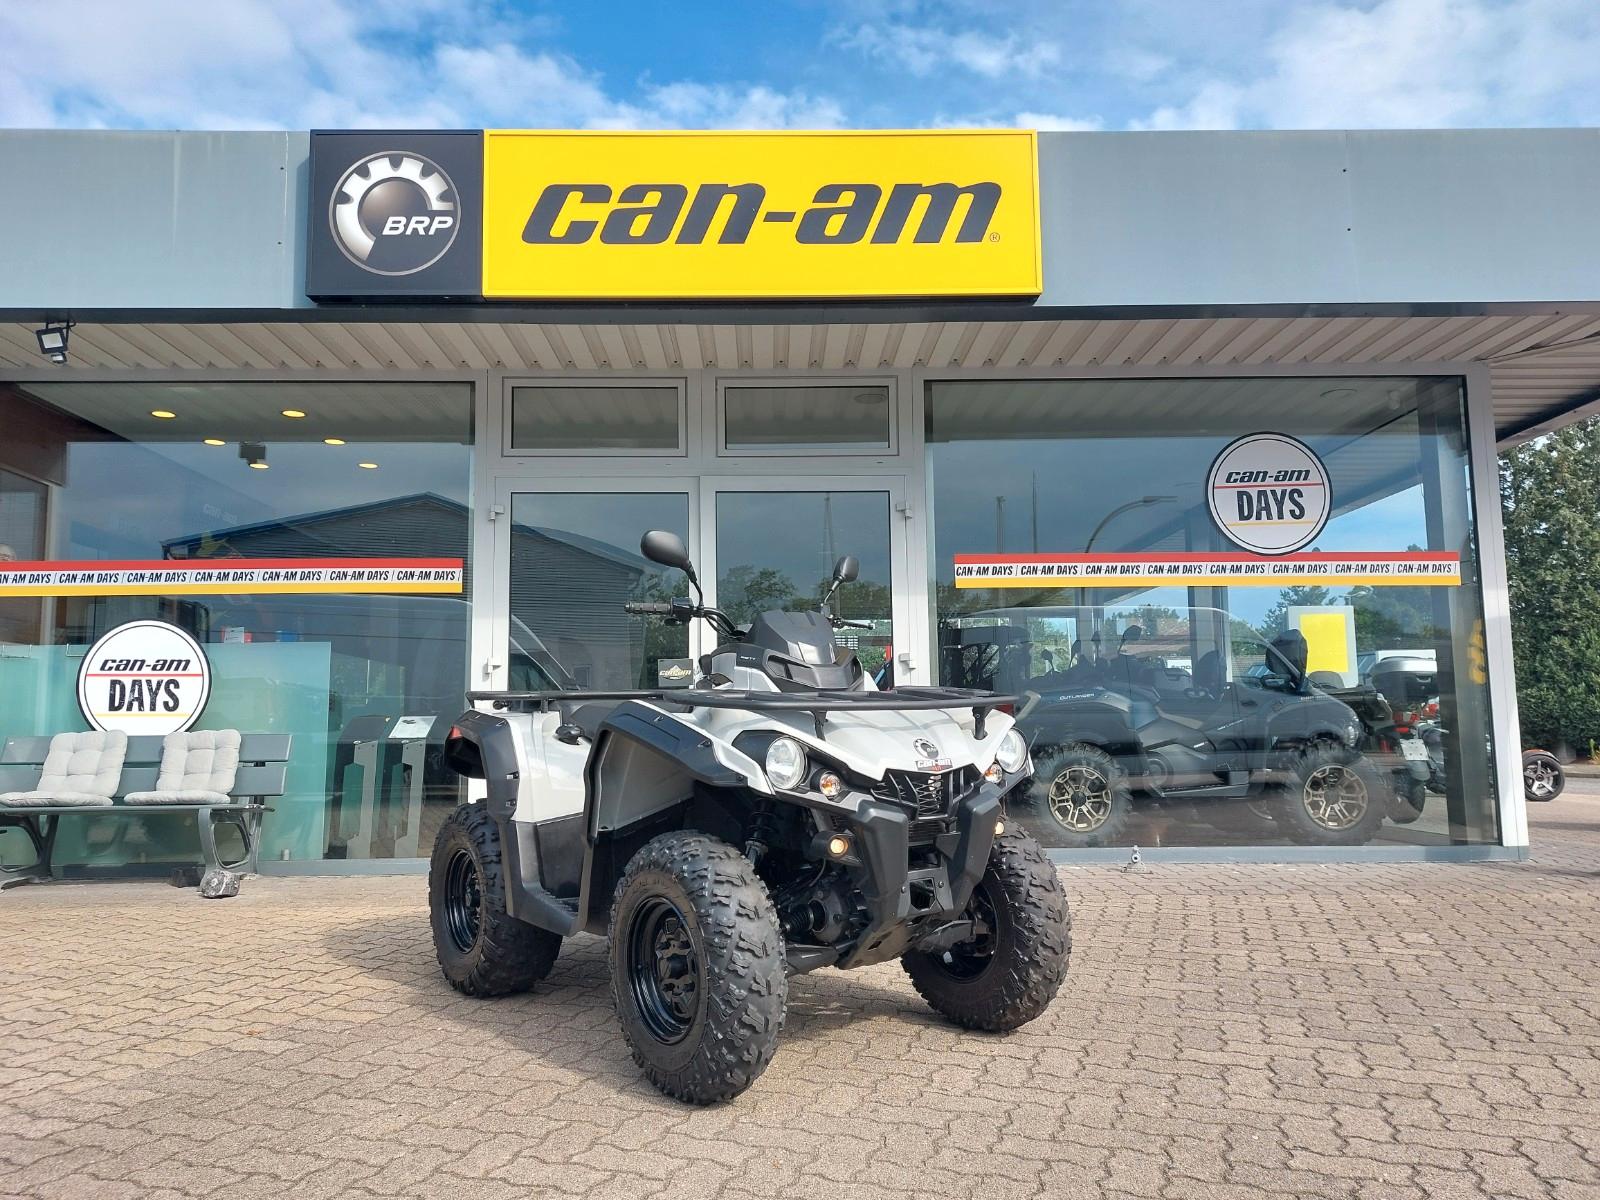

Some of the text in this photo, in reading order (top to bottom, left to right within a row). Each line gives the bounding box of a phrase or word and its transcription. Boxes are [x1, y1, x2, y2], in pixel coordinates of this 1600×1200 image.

[521, 181, 1002, 243] can-am
[381, 215, 454, 236] BRP
[1225, 469, 1311, 484] can-am
[1236, 488, 1306, 521] DAYS
[28, 573, 52, 584] DAYS
[58, 572, 94, 583] CAN-AM
[97, 572, 119, 583] DAYS
[126, 572, 162, 582] CAN-AM
[165, 572, 187, 582] DAYS
[194, 571, 230, 581] CAN-AM
[232, 571, 254, 581] DAYS
[262, 571, 297, 581] CAN-AM
[300, 571, 322, 581] DAYS
[329, 570, 364, 580] CAN-AM
[367, 570, 389, 580] DAYS
[396, 570, 431, 580] CAN-AM
[434, 570, 455, 580] DAYS
[955, 563, 1451, 576] CAN-AM DAYS CAN-AM DAYS CAN-AM DAYS CAN-AM DAYS CAN-AM DAYS CAN-AM DAYS CAN-AM DAYS CAN-AM DAYS
[99, 658, 191, 672] can-am
[107, 678, 181, 712] DAYS
